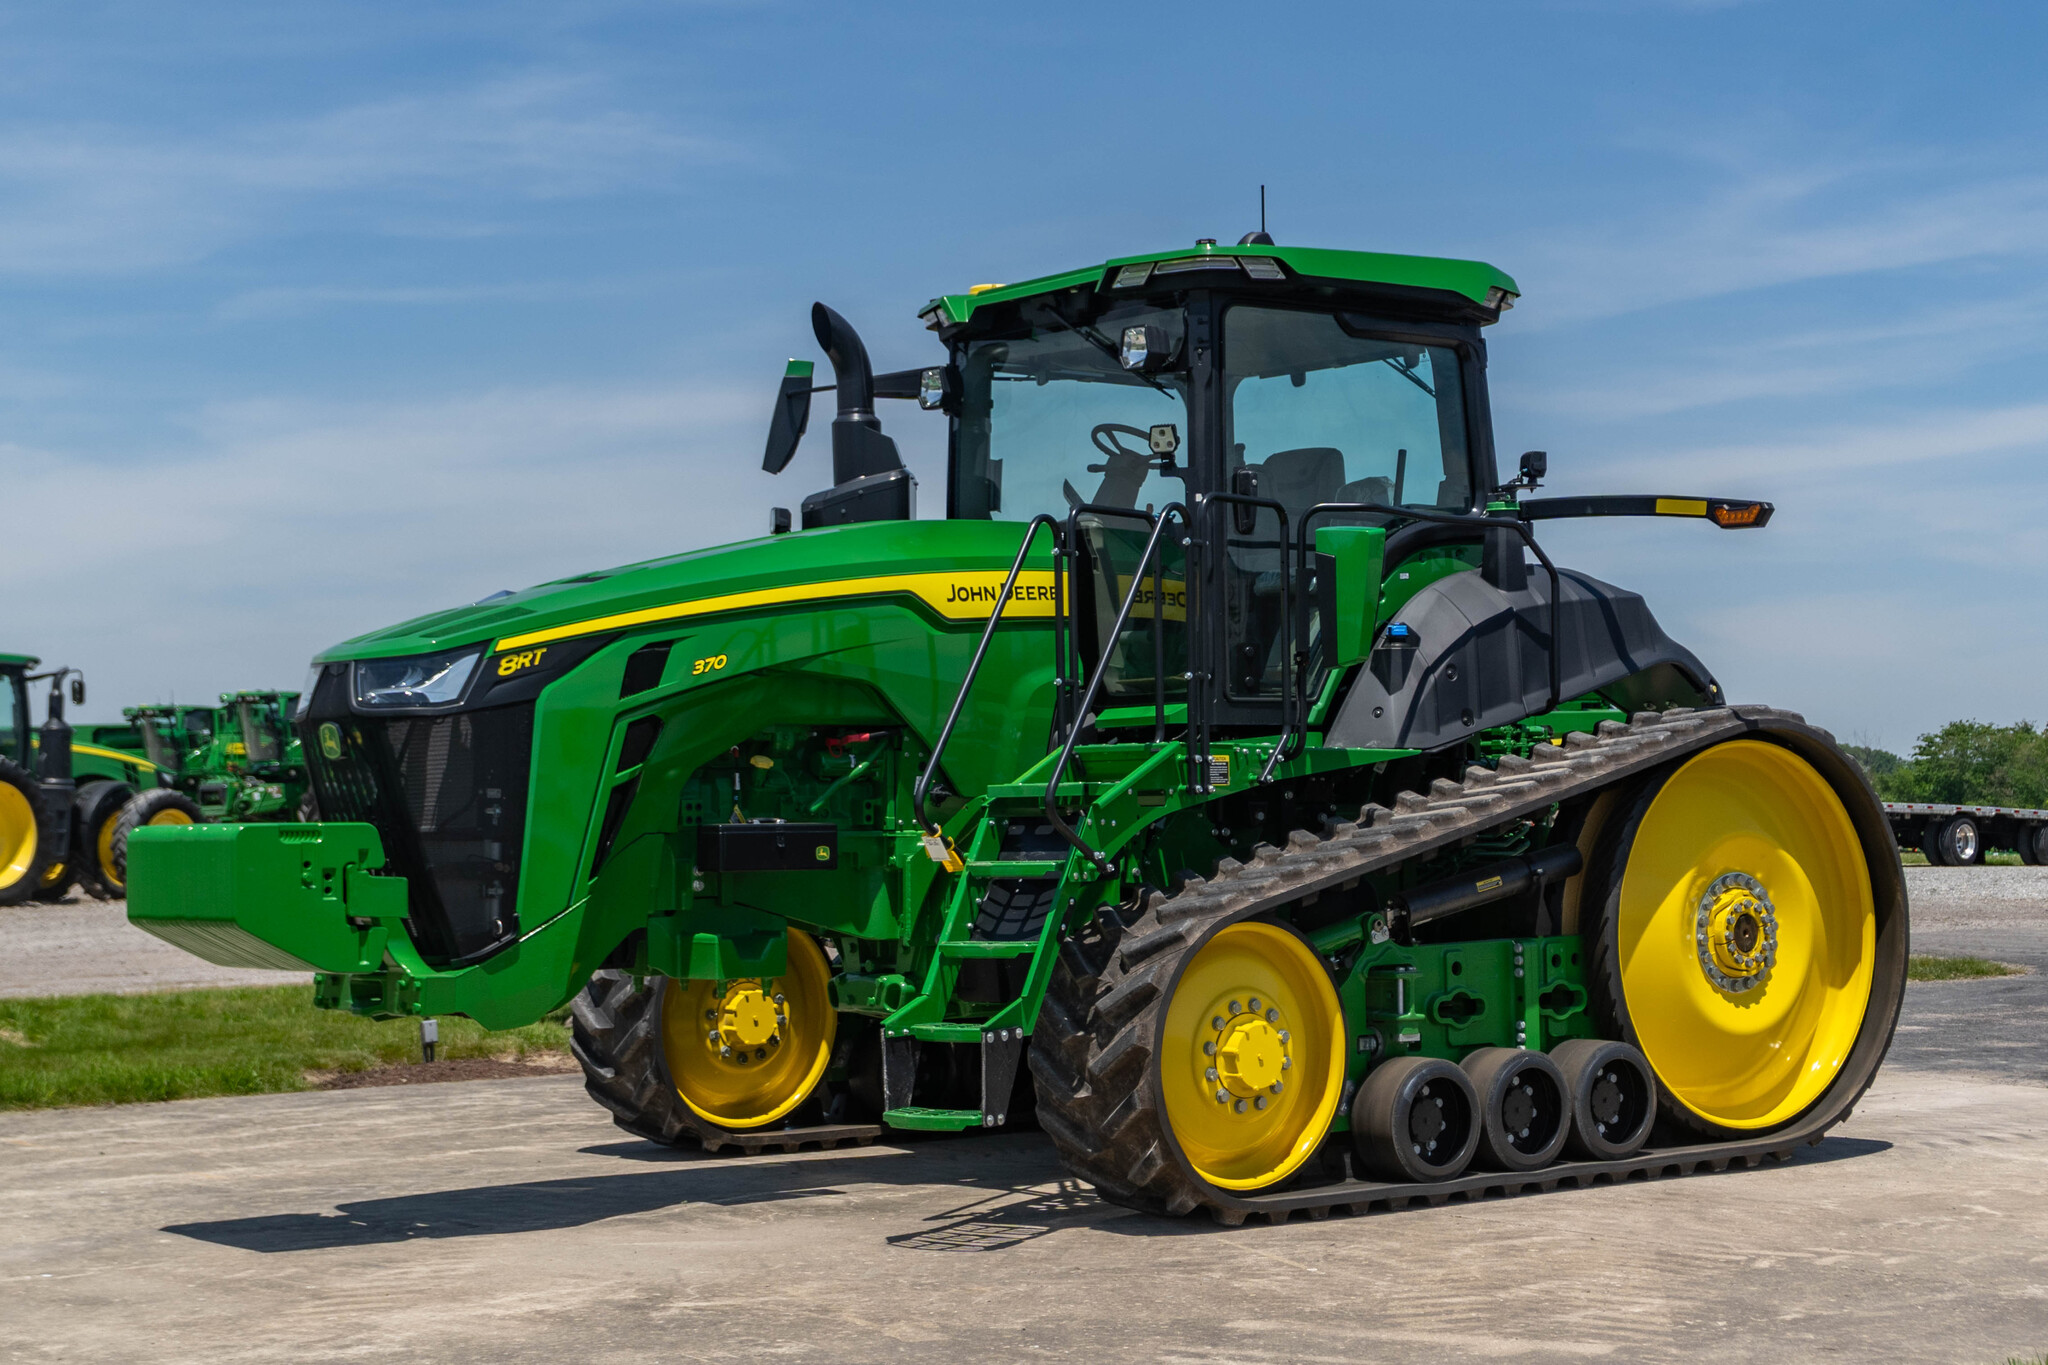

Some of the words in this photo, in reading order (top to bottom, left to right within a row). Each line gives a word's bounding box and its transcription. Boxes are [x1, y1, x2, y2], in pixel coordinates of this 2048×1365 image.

[947, 583, 997, 602] JOHN
[497, 647, 547, 676] 8RT
[692, 654, 728, 676] 370
